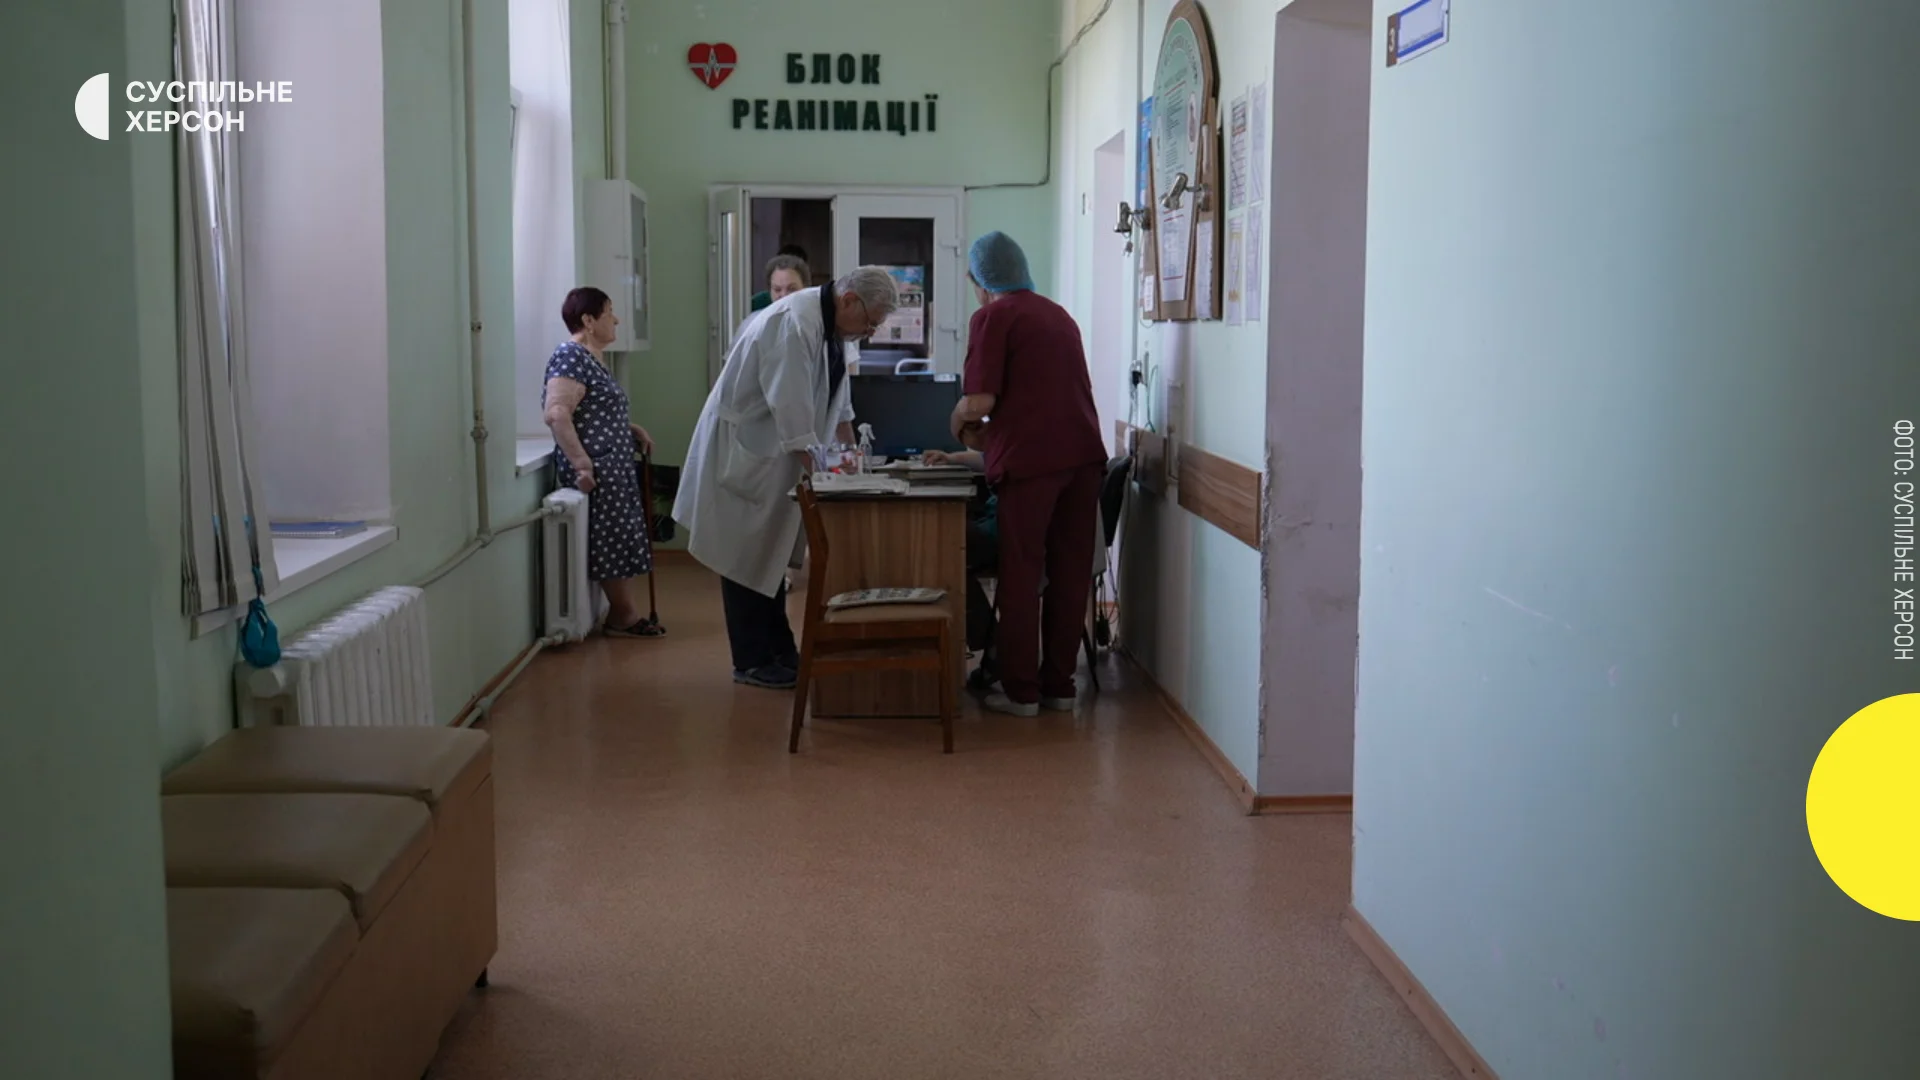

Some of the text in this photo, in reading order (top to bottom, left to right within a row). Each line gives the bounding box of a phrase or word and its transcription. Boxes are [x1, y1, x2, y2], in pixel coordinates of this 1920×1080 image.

[1389, 27, 1396, 53] 3
[785, 52, 881, 85] БЛОК
[732, 93, 939, 136] РЕАНІМАЦІЇ
